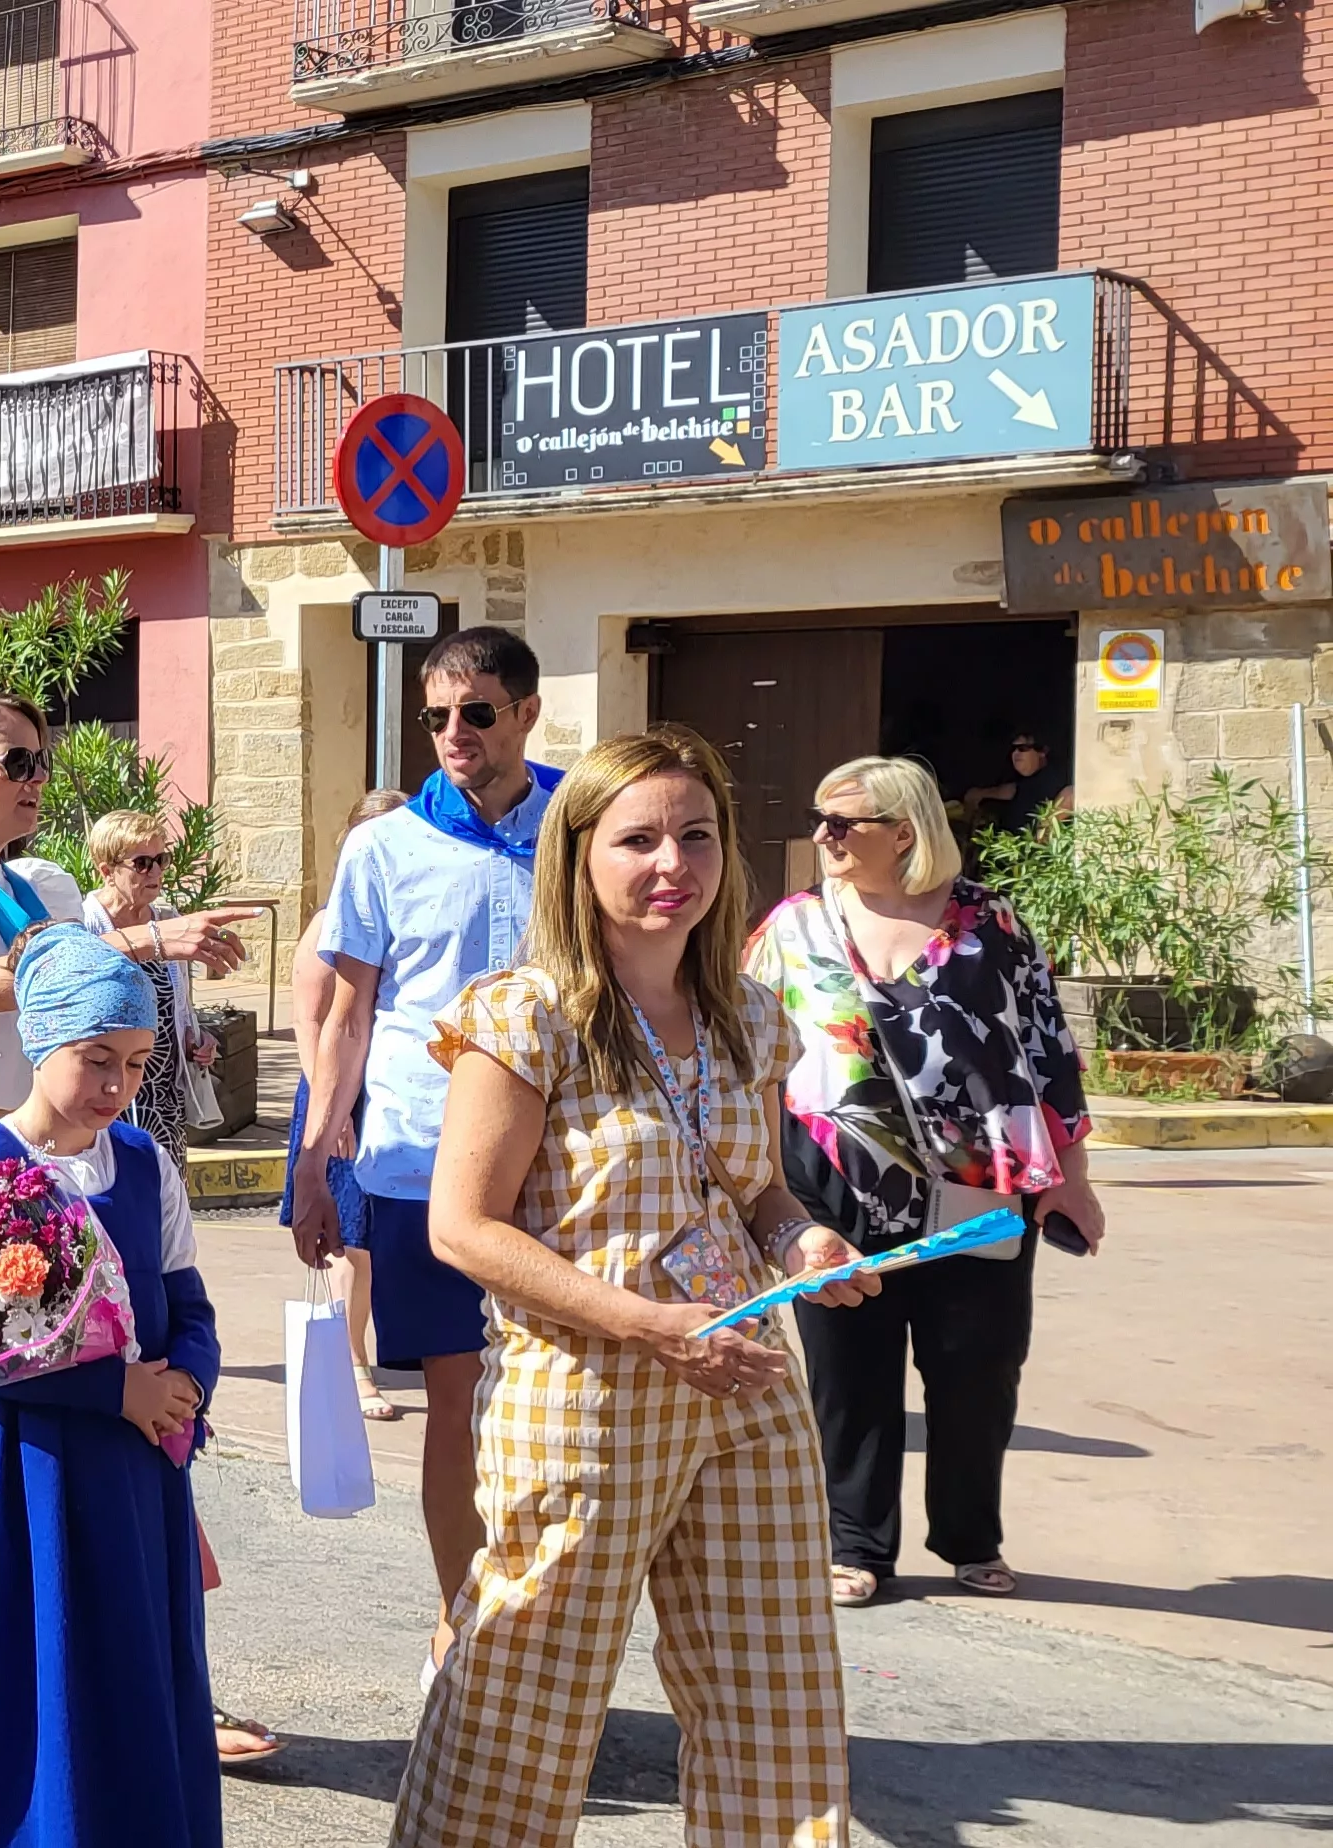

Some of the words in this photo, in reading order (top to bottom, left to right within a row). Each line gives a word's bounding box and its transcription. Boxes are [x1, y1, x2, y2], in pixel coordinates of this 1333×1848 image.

[793, 298, 1065, 378] ASADOR
[515, 328, 751, 421] HOTEL
[623, 421, 641, 436] de
[640, 416, 733, 443] belchite
[828, 380, 963, 443] BAR
[1100, 552, 1303, 598] belchite
[380, 599, 419, 610] EXCEPTO
[385, 612, 414, 622] CARGA
[373, 624, 379, 634] Y
[380, 624, 426, 635] DESCARGA
